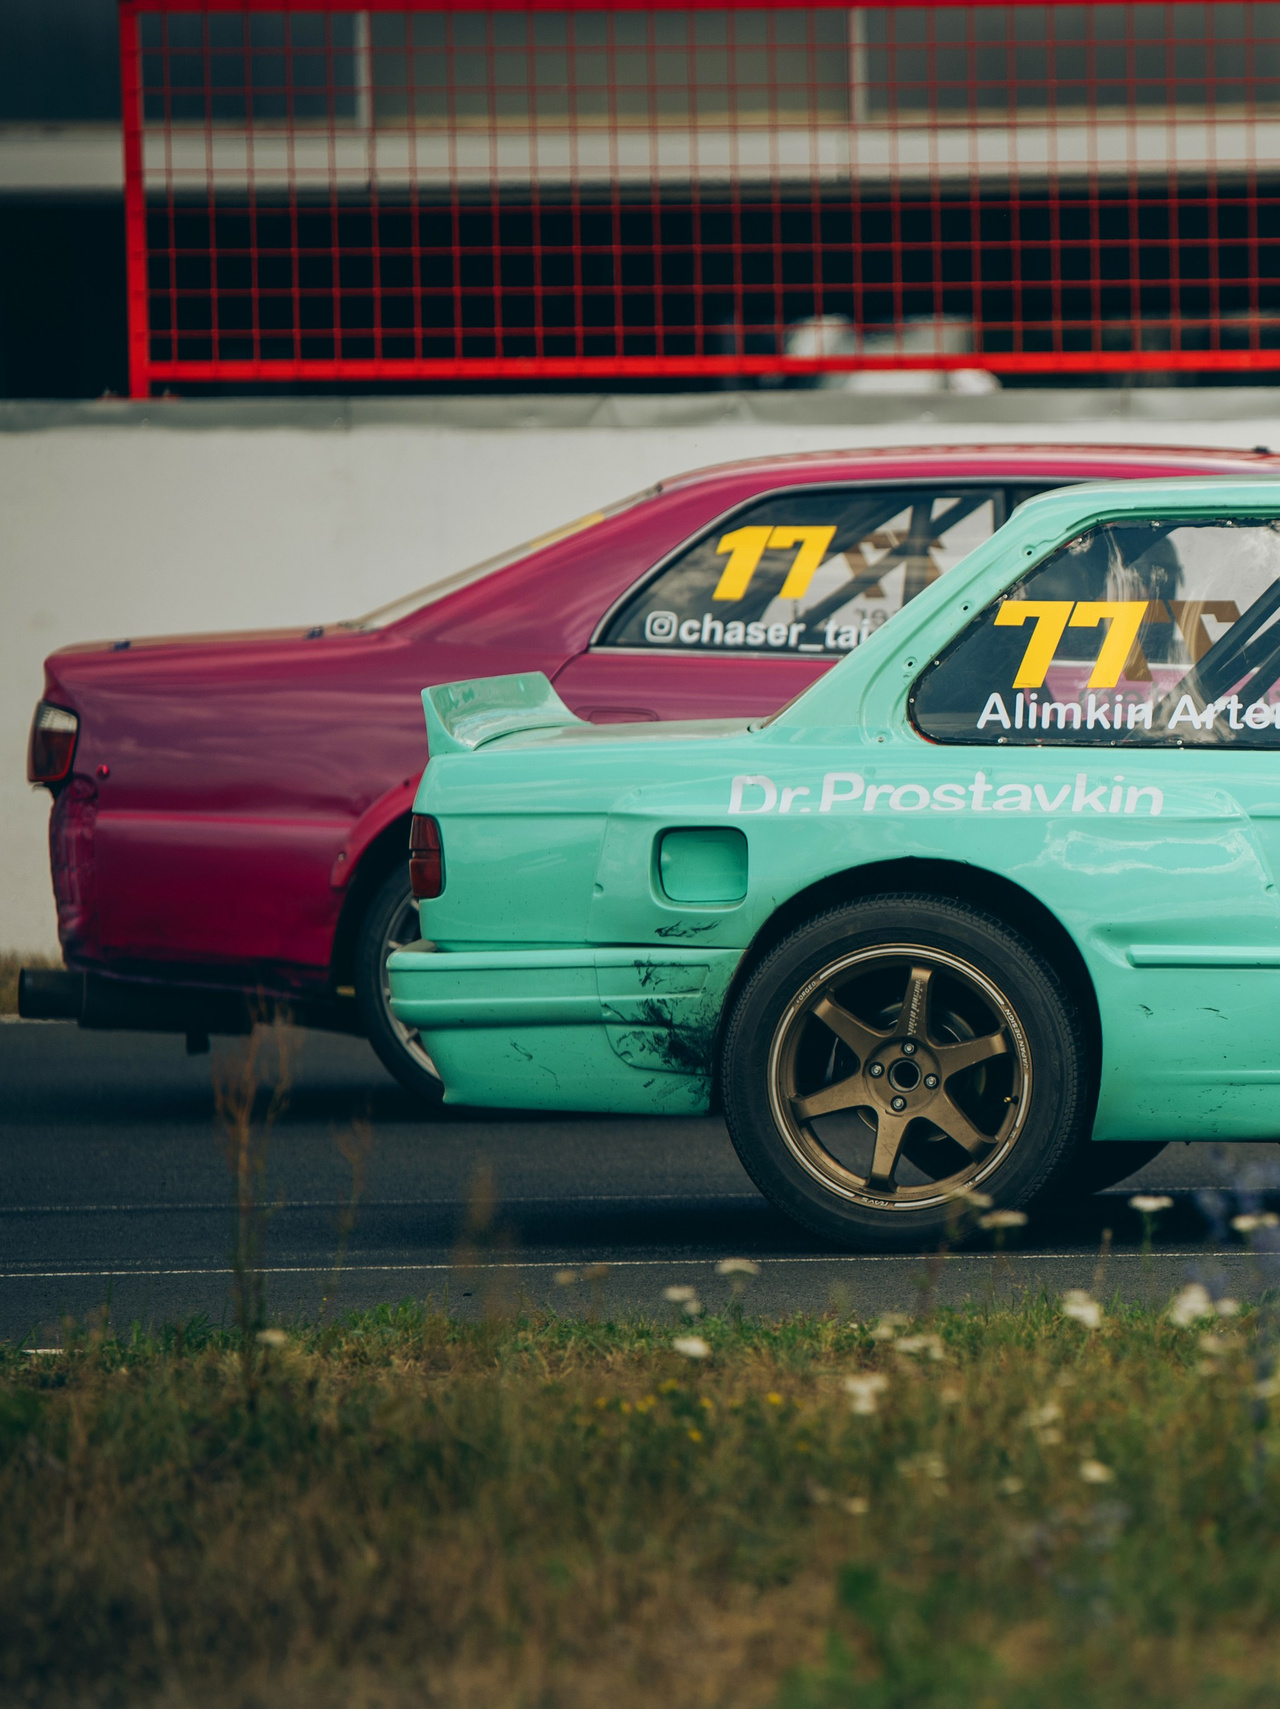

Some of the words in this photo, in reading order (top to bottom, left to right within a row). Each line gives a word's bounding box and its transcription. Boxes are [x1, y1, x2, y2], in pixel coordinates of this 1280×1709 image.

[713, 525, 838, 601] 17
[993, 600, 1150, 690] 77
[976, 692, 1152, 730] Alimkin
[860, 1196, 890, 1208] RAYS
